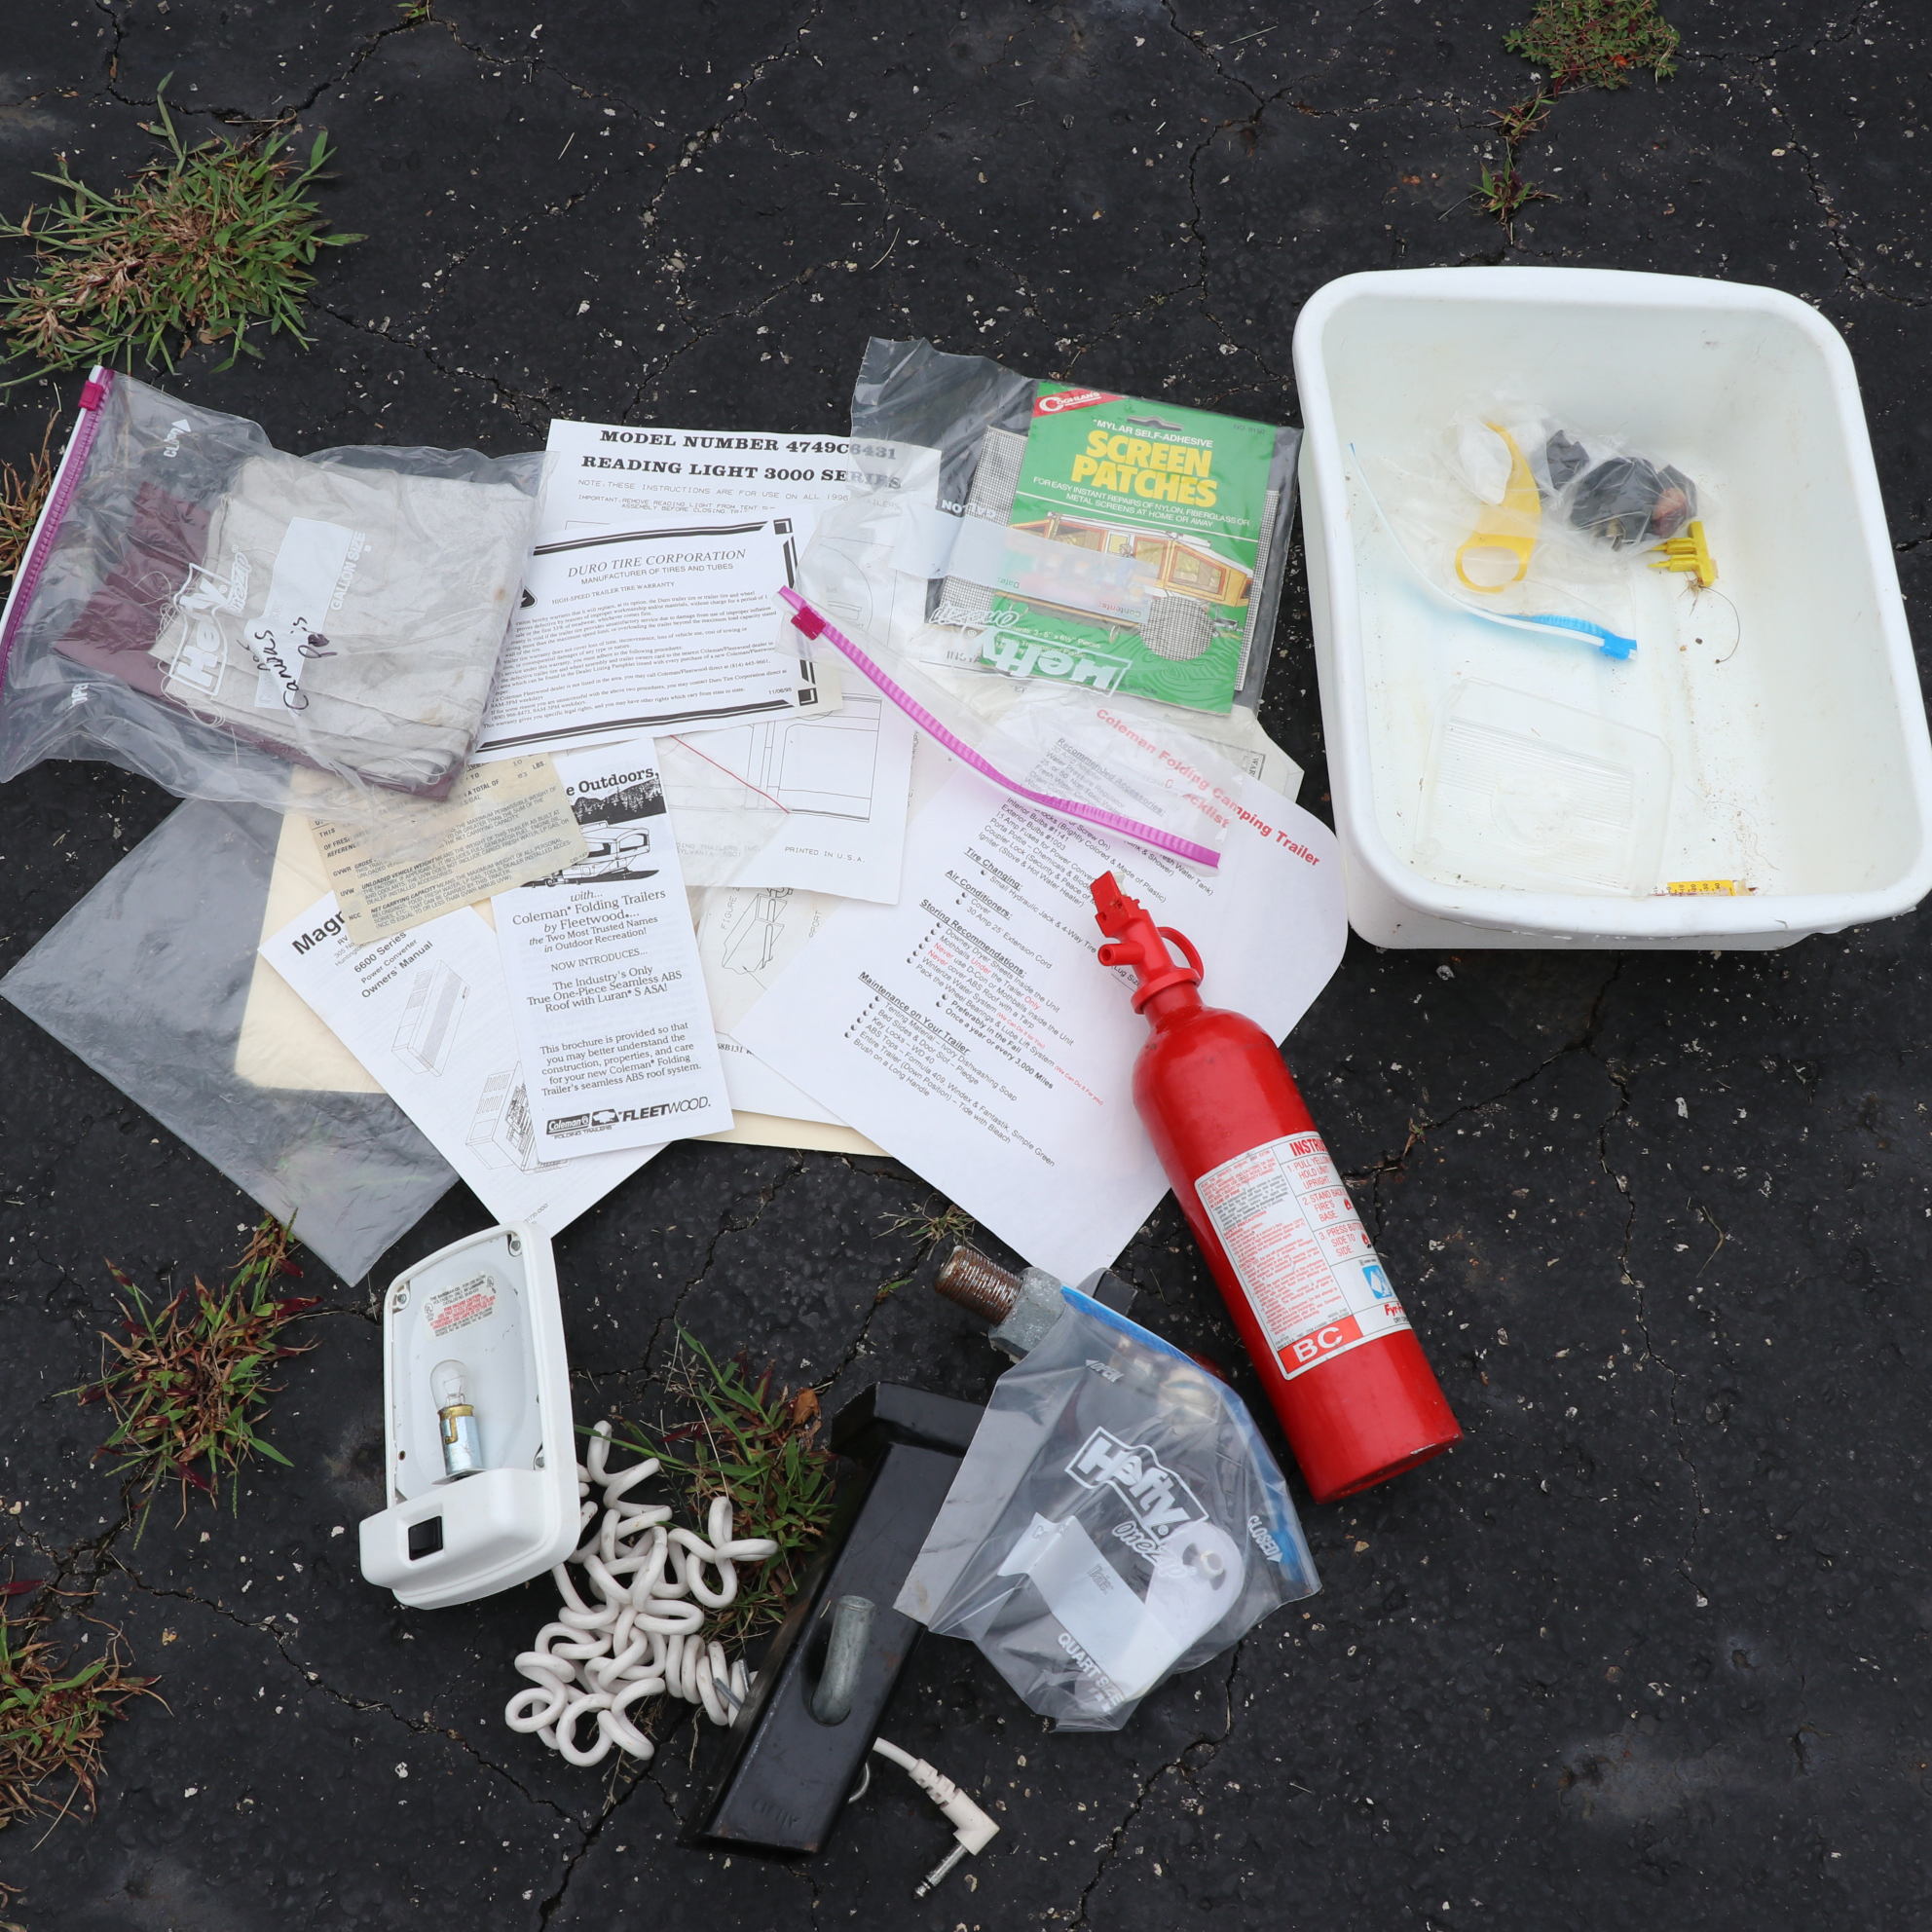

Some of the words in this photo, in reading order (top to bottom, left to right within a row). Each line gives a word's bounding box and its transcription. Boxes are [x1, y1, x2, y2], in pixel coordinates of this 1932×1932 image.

[600, 430, 676, 446] MODEL
[682, 436, 778, 450] NUMBER
[785, 441, 895, 459] 4749C6431
[1134, 428, 1213, 447] SELF-ADHESIVE
[1086, 430, 1212, 478] SCREEN
[581, 455, 681, 473] READING
[688, 463, 758, 478] LIGHT
[764, 468, 814, 481] 3000
[820, 469, 900, 489] SERIES
[1071, 454, 1217, 508] PATCHES
[1033, 476, 1051, 486] FOR
[1051, 481, 1072, 491] EASY
[1073, 486, 1107, 499] INSTANT
[1107, 494, 1141, 507] REPAIRS
[1154, 503, 1184, 514] NYLON,
[1185, 509, 1236, 523] FIBERGLASS
[1066, 493, 1092, 504] METAL
[1095, 499, 1135, 513] SCREENS
[1148, 510, 1173, 520] HOME
[1190, 518, 1213, 526] AWAY
[330, 558, 357, 611] GALLON
[347, 532, 366, 562] SIZE
[568, 561, 607, 577] DURO
[611, 557, 641, 569] TIRE
[646, 549, 745, 565] CORPORATION
[581, 569, 647, 584] MANUFACTURER
[551, 593, 590, 604] HIGH-SPEED
[591, 587, 618, 597] TRAILER
[1099, 602, 1141, 618] Contents:
[578, 768, 659, 793] Outdoors,
[1096, 709, 1157, 754] Coleman
[1158, 750, 1210, 791] Folding
[1212, 787, 1273, 838] Camping
[1275, 831, 1320, 866] Trailer
[784, 846, 818, 855] PRINTED
[837, 853, 864, 862] U.S.A.
[963, 847, 981, 862] Tire
[981, 859, 1022, 889] Changing:
[332, 866, 351, 876] GVWR
[361, 875, 391, 889] UNLOADED
[391, 867, 412, 878] VEHICLE
[413, 858, 434, 870] WEIGHT
[340, 887, 354, 896] UVW
[382, 895, 409, 909] CARRYING
[410, 885, 435, 899] CAPACITY
[570, 889, 602, 902] with...
[574, 899, 619, 914] Folding
[621, 890, 665, 905] Trailers
[944, 870, 959, 884] Air
[956, 878, 1012, 918] Conditioners:
[348, 912, 361, 920] NCC
[529, 937, 543, 945] the
[545, 934, 565, 942] Two
[567, 928, 589, 939] Most
[590, 921, 624, 934] Trusted
[626, 916, 658, 928] Names
[354, 953, 376, 972] 6600
[376, 929, 406, 955] Series
[555, 938, 593, 950] Outdoor
[594, 926, 646, 943] Recreation!
[919, 899, 950, 924] Storing
[950, 919, 1026, 976] Recommendations:
[360, 965, 383, 983] Power
[383, 939, 416, 966] Converter
[361, 966, 397, 997] Owners'
[398, 940, 433, 968] Manual
[550, 960, 575, 972] NOW
[578, 948, 647, 966] INTRODUCES...
[526, 996, 550, 1005] True
[553, 985, 607, 1000] One-Piece
[609, 976, 658, 990] Seamless
[661, 970, 682, 981] ABS
[552, 981, 573, 990] The
[575, 970, 626, 986] Industry's
[628, 965, 652, 976] Only
[545, 999, 569, 1012] Roof
[572, 996, 595, 1007] with
[634, 987, 641, 996] S
[644, 983, 667, 995] ASA!
[858, 971, 909, 1011] Maintenance
[910, 1010, 921, 1019] on
[923, 1016, 942, 1034] Your
[539, 1044, 559, 1054] This
[561, 1038, 603, 1050] brochure
[605, 1035, 613, 1043] is
[615, 1027, 655, 1043] provided
[670, 1022, 688, 1031] that
[546, 1056, 564, 1066] you
[566, 1052, 585, 1061] may
[587, 1047, 614, 1057] better
[617, 1035, 669, 1051] understand
[670, 1033, 685, 1042] the
[541, 1060, 601, 1075] construction,
[603, 1051, 652, 1066] properties,
[654, 1046, 672, 1055] and
[674, 1043, 694, 1052] care
[549, 1076, 562, 1084] for
[564, 1073, 585, 1084] your
[587, 1069, 607, 1078] new
[657, 1054, 691, 1066] Folding
[541, 1083, 579, 1096] Trailer's
[581, 1077, 623, 1090] seamless
[625, 1071, 644, 1082] ABS
[646, 1067, 665, 1078] roof
[667, 1063, 701, 1076] system.
[1293, 1158, 1312, 1170] PULL
[1298, 1168, 1317, 1180] HOLD
[1317, 1165, 1329, 1175] UNIT
[1310, 1189, 1332, 1203] STAND
[1314, 1200, 1335, 1213] FIRE'S
[1318, 1210, 1339, 1222] BASE.
[1326, 1223, 1349, 1237] PRESS
[1331, 1236, 1347, 1247] SIDE
[1347, 1234, 1356, 1243] TO
[1335, 1246, 1354, 1257] SIDE.
[1292, 1327, 1343, 1363] BC
[1077, 1436, 1191, 1528] Hefty
[1057, 1632, 1102, 1677] QUART
[1095, 1676, 1125, 1706] SIZE
